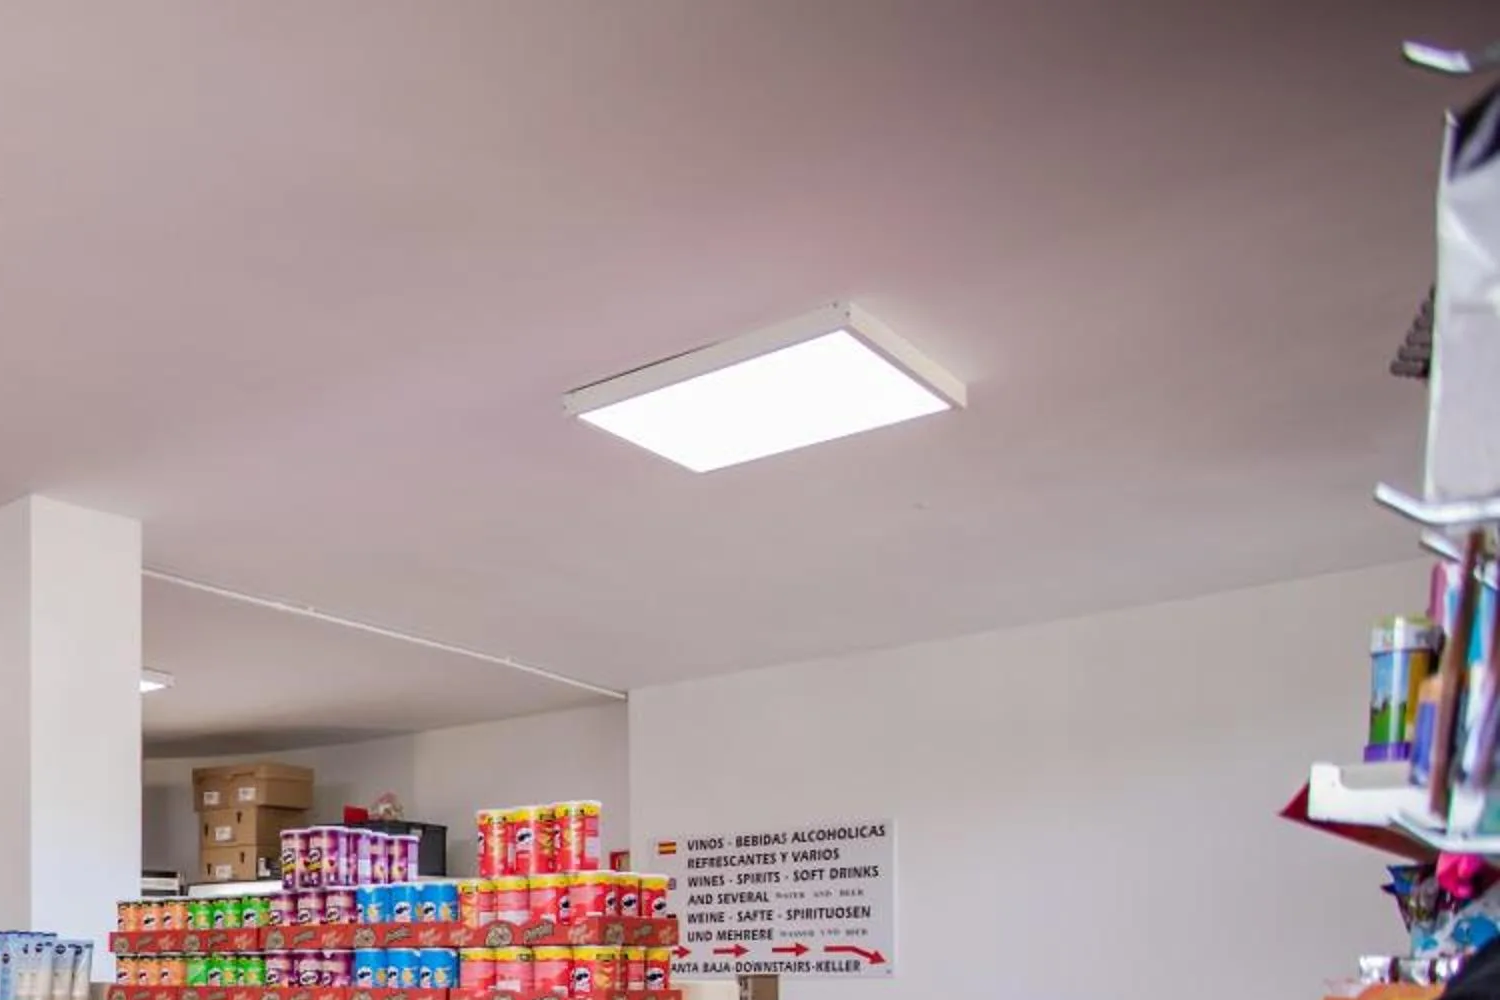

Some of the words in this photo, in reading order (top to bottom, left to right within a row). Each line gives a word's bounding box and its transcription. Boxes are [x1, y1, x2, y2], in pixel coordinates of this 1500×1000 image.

[687, 838, 724, 851] VINOS
[735, 834, 787, 848] BEBIDAS
[791, 824, 886, 843] ALCOHOLICAS
[687, 853, 777, 869] REFRESCANTES
[780, 852, 788, 863] Y
[791, 848, 840, 863] VARIOS
[687, 875, 725, 888] WINES
[737, 872, 781, 886] SPIRITS
[793, 869, 824, 882] SOFT
[829, 865, 879, 880] DRINKS
[687, 892, 713, 906] AND
[717, 890, 769, 904] SEVERAL
[687, 912, 725, 925] WEINE
[786, 905, 871, 921] SPIRITUOSEN
[687, 930, 713, 943] UND
[716, 927, 774, 942] MEHRERE
[671, 962, 698, 974] ANTA
